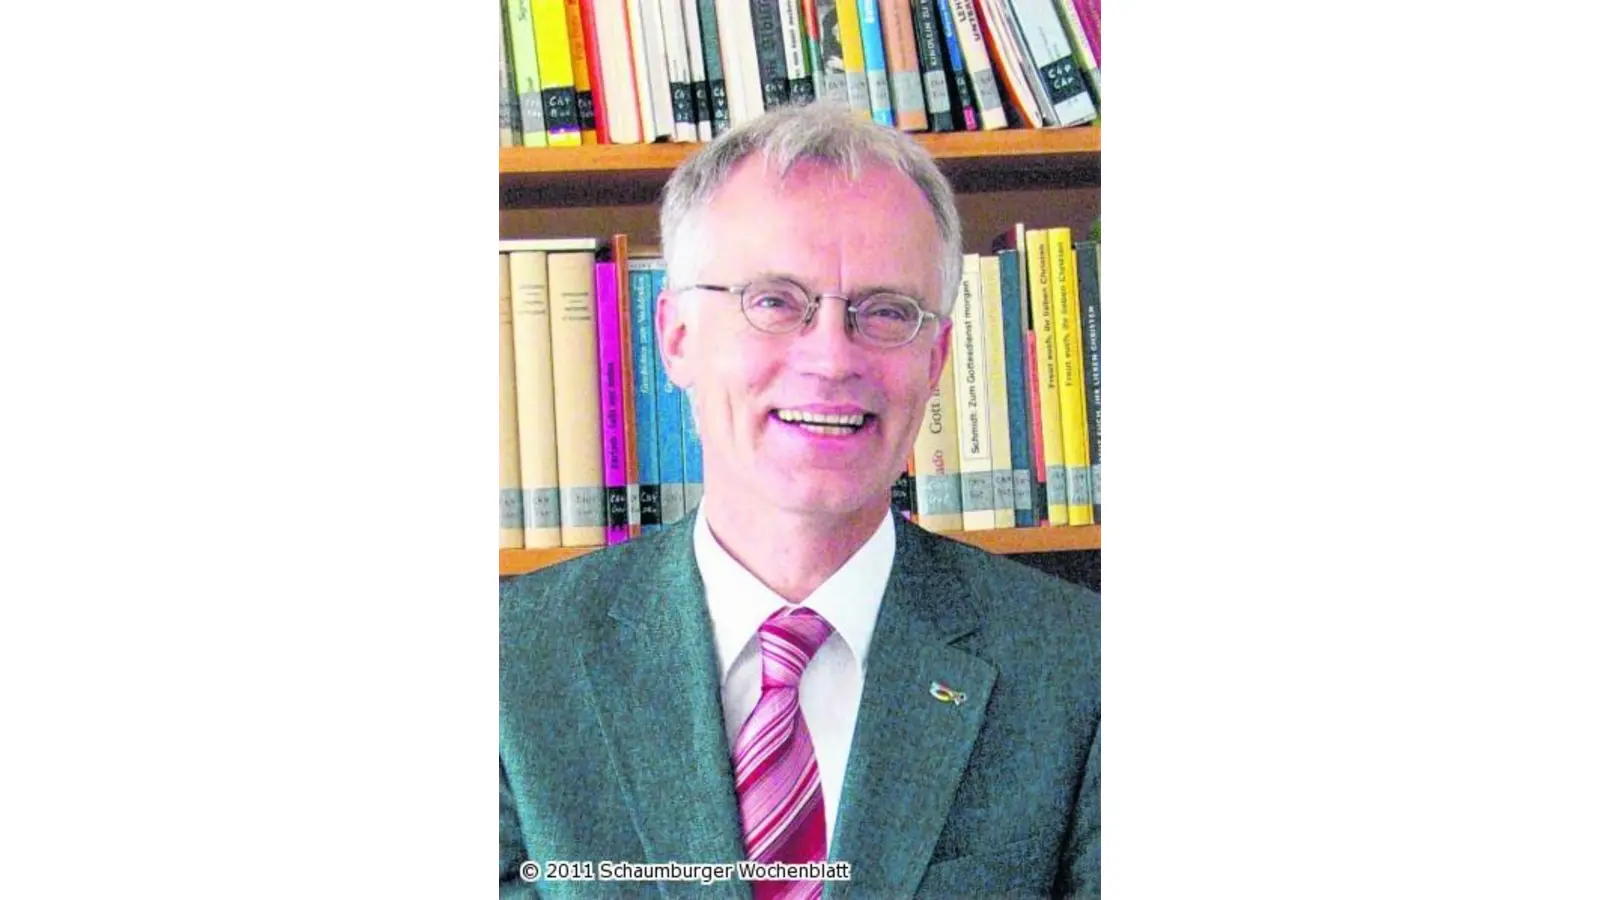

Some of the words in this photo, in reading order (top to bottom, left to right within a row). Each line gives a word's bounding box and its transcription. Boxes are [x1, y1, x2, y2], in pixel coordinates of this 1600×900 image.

[962, 279, 971, 317] morgen
[964, 319, 976, 384] Gottesdienst
[968, 384, 978, 408] Zum
[929, 402, 943, 435] Gott
